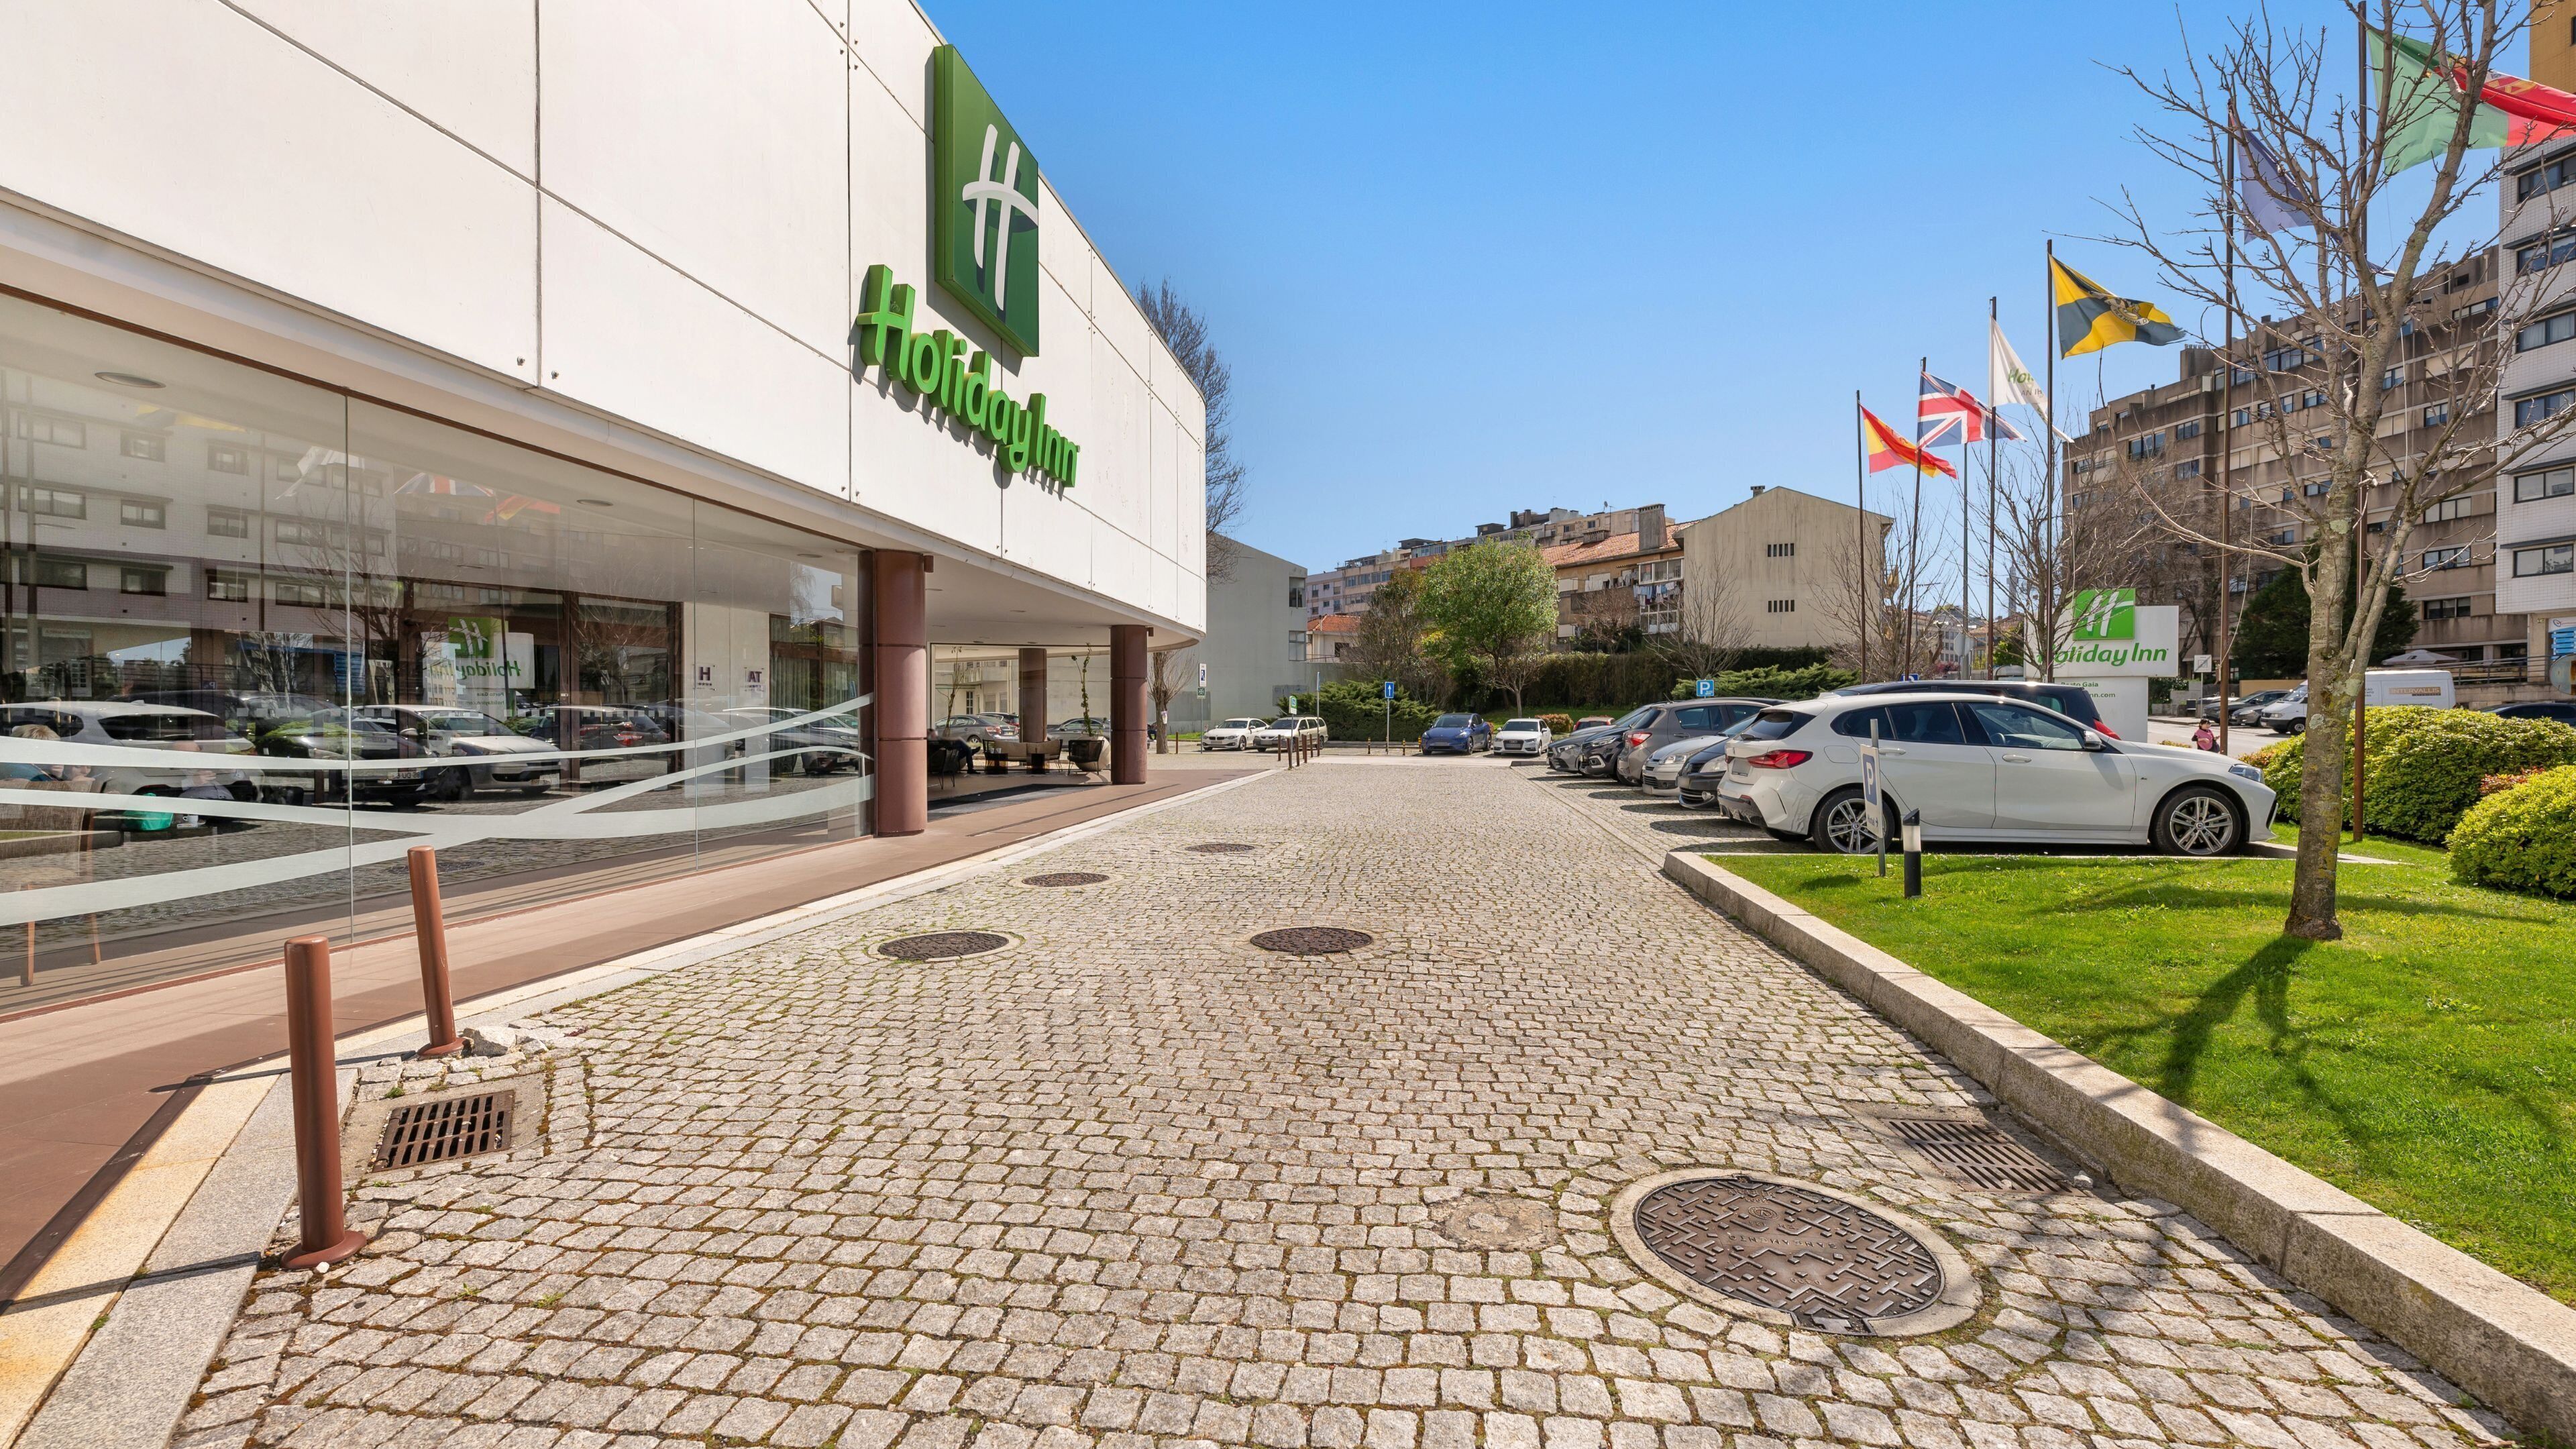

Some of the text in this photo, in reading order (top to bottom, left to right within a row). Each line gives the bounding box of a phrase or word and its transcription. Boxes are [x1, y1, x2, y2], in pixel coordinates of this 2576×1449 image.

[856, 264, 1078, 488] Holiday Inn
[2037, 642, 2167, 666] oliday Inn
[699, 666, 711, 681] H
[747, 671, 762, 683] AT
[1700, 682, 1711, 695] P
[1866, 761, 1874, 795] P
[1728, 1234, 1837, 1249] SANEAMENTO
